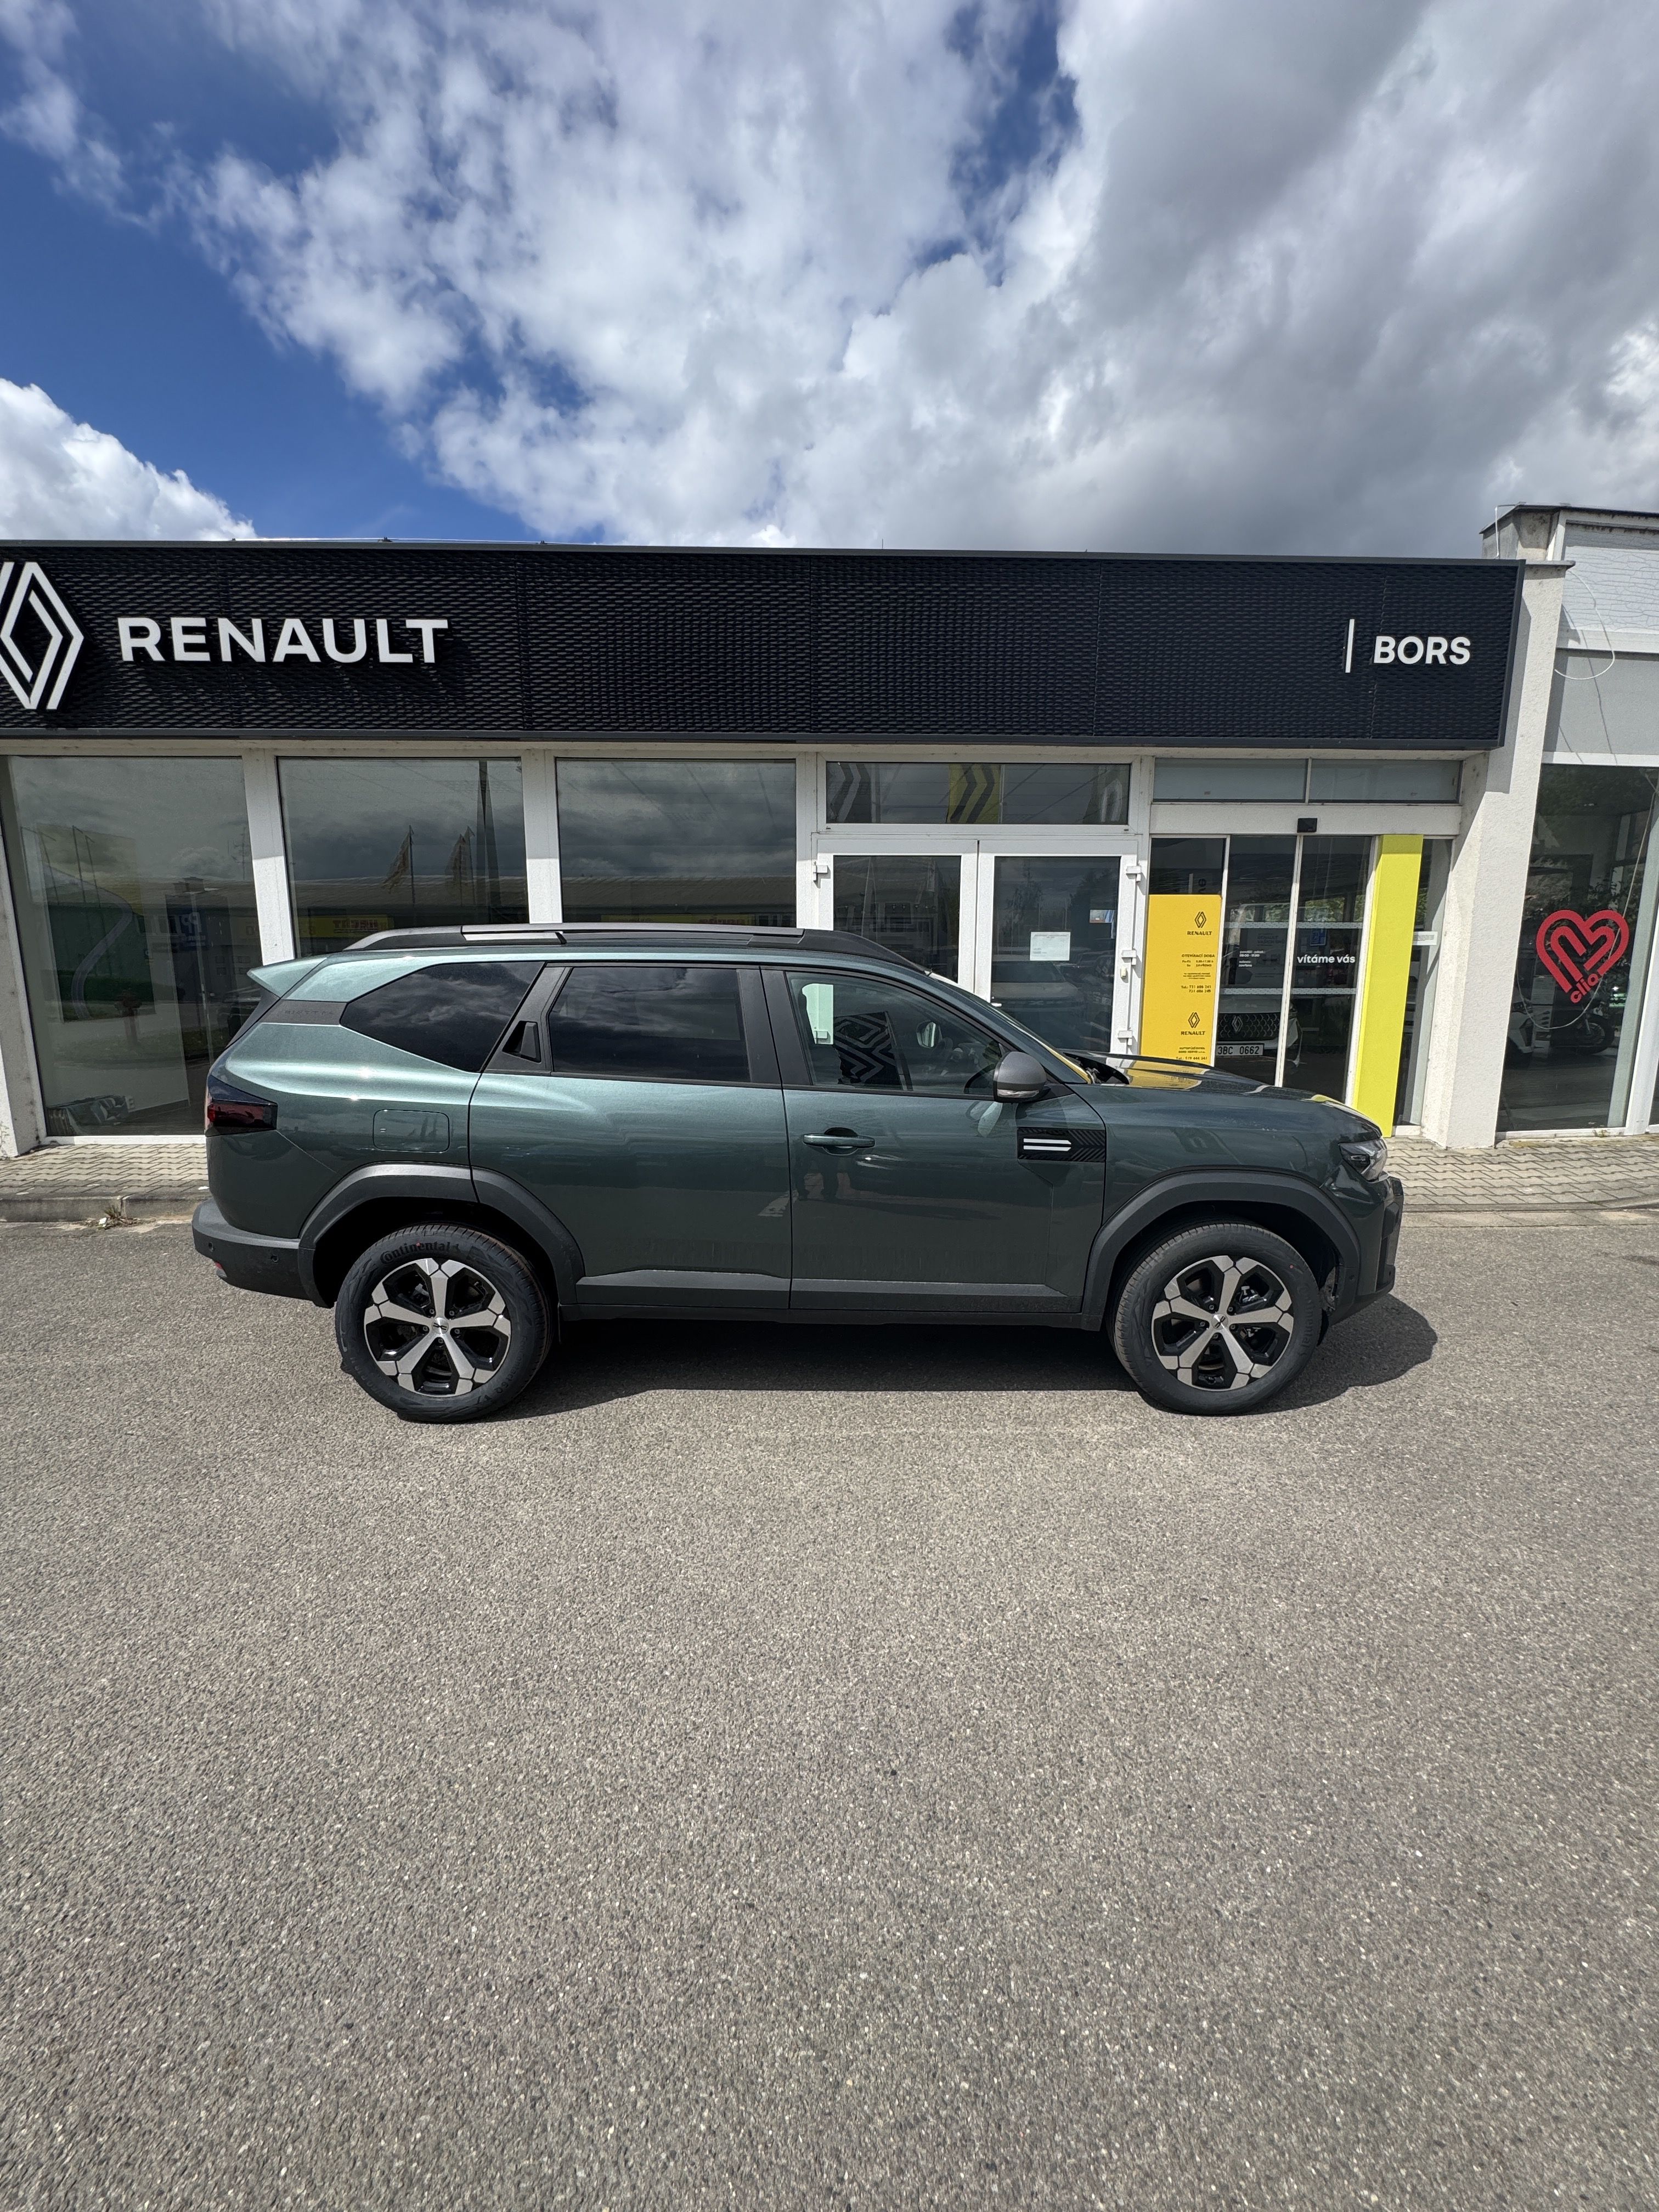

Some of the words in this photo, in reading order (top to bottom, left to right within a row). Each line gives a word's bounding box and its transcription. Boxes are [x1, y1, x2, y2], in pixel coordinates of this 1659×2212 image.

[117, 617, 449, 664] RENAULT
[1373, 635, 1471, 665] BORS
[1296, 953, 1335, 964] vítáme
[1335, 954, 1356, 964] vás
[1571, 973, 1599, 1003] clio
[1217, 1046, 1233, 1055] 3BC
[1239, 1046, 1260, 1054] 0662
[380, 1242, 451, 1263] Continental
